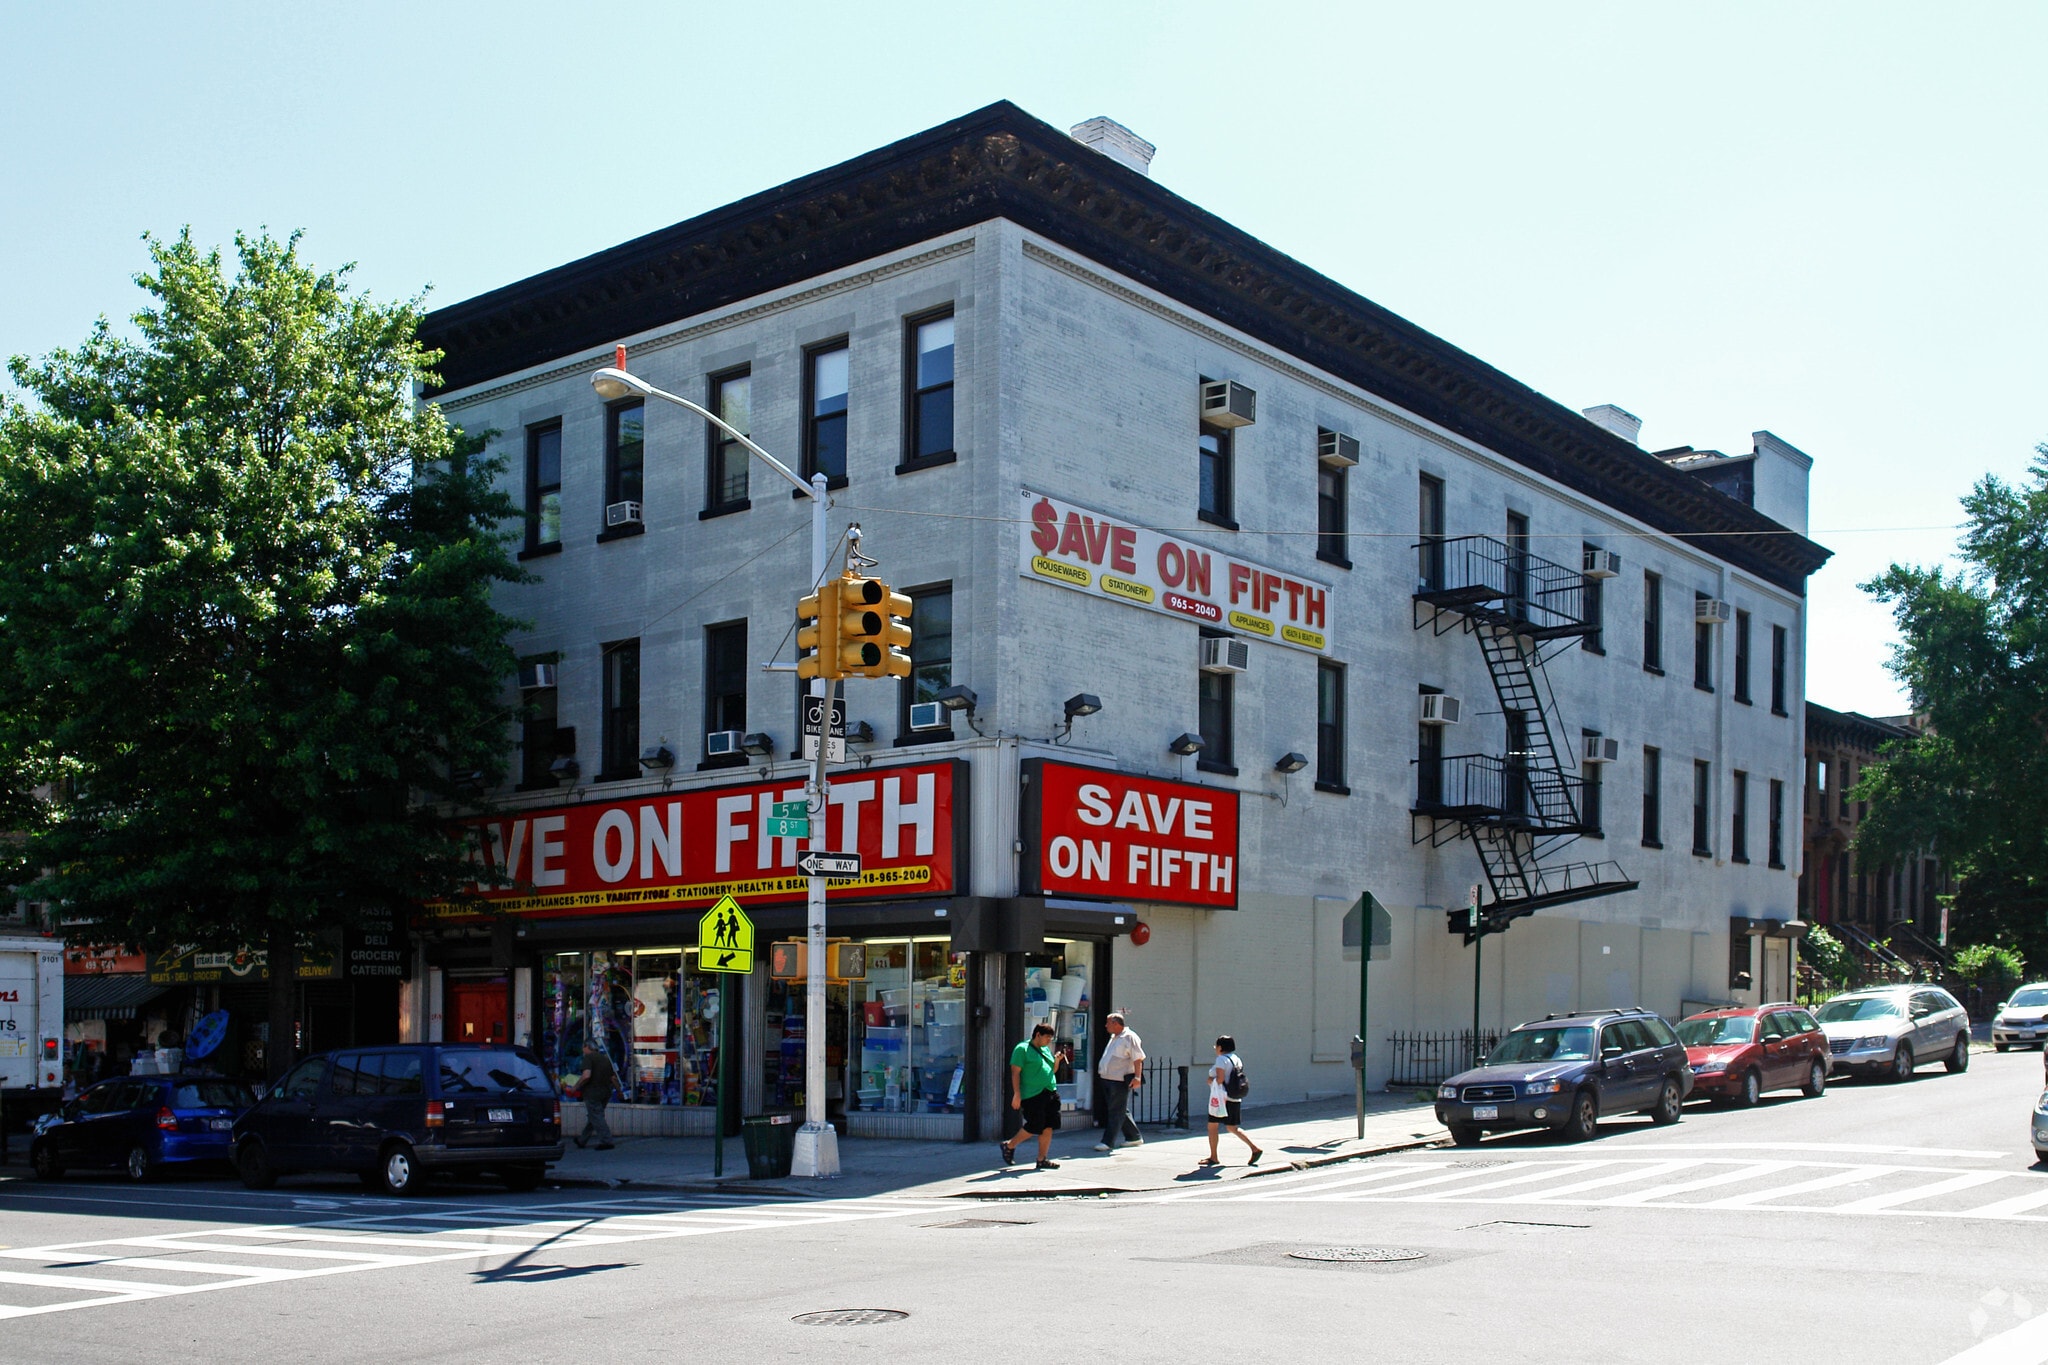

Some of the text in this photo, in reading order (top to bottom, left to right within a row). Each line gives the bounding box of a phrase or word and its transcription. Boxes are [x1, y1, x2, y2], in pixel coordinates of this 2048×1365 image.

[1021, 490, 1031, 498] 421
[1031, 497, 1325, 629] $AVE ON FIFTH
[1037, 559, 1087, 581] HOUSEWARES
[1108, 578, 1148, 597] STATIONERY
[1236, 615, 1270, 632] APPLIANCES
[806, 724, 844, 736] BIKE ANE
[813, 740, 836, 749] BES
[815, 749, 835, 759] OLY
[782, 803, 800, 818] 5 AV
[1077, 784, 1213, 840] SAVE
[779, 820, 798, 835] 8 ST
[456, 815, 567, 892] AVE
[593, 802, 683, 884] ON
[806, 859, 854, 870] ONE WAY
[1050, 835, 1233, 894] ON FIFTH
[525, 895, 575, 908] APPLIANCES
[579, 893, 600, 905] TOYS
[677, 884, 733, 898] STATIONERY
[738, 881, 774, 893] HEALTH
[777, 878, 784, 890] &
[365, 935, 389, 946] DELI
[42, 955, 59, 963] 9101
[351, 950, 402, 961] GROCERY
[299, 966, 333, 977] DELIVERY
[351, 964, 402, 976] CATERING
